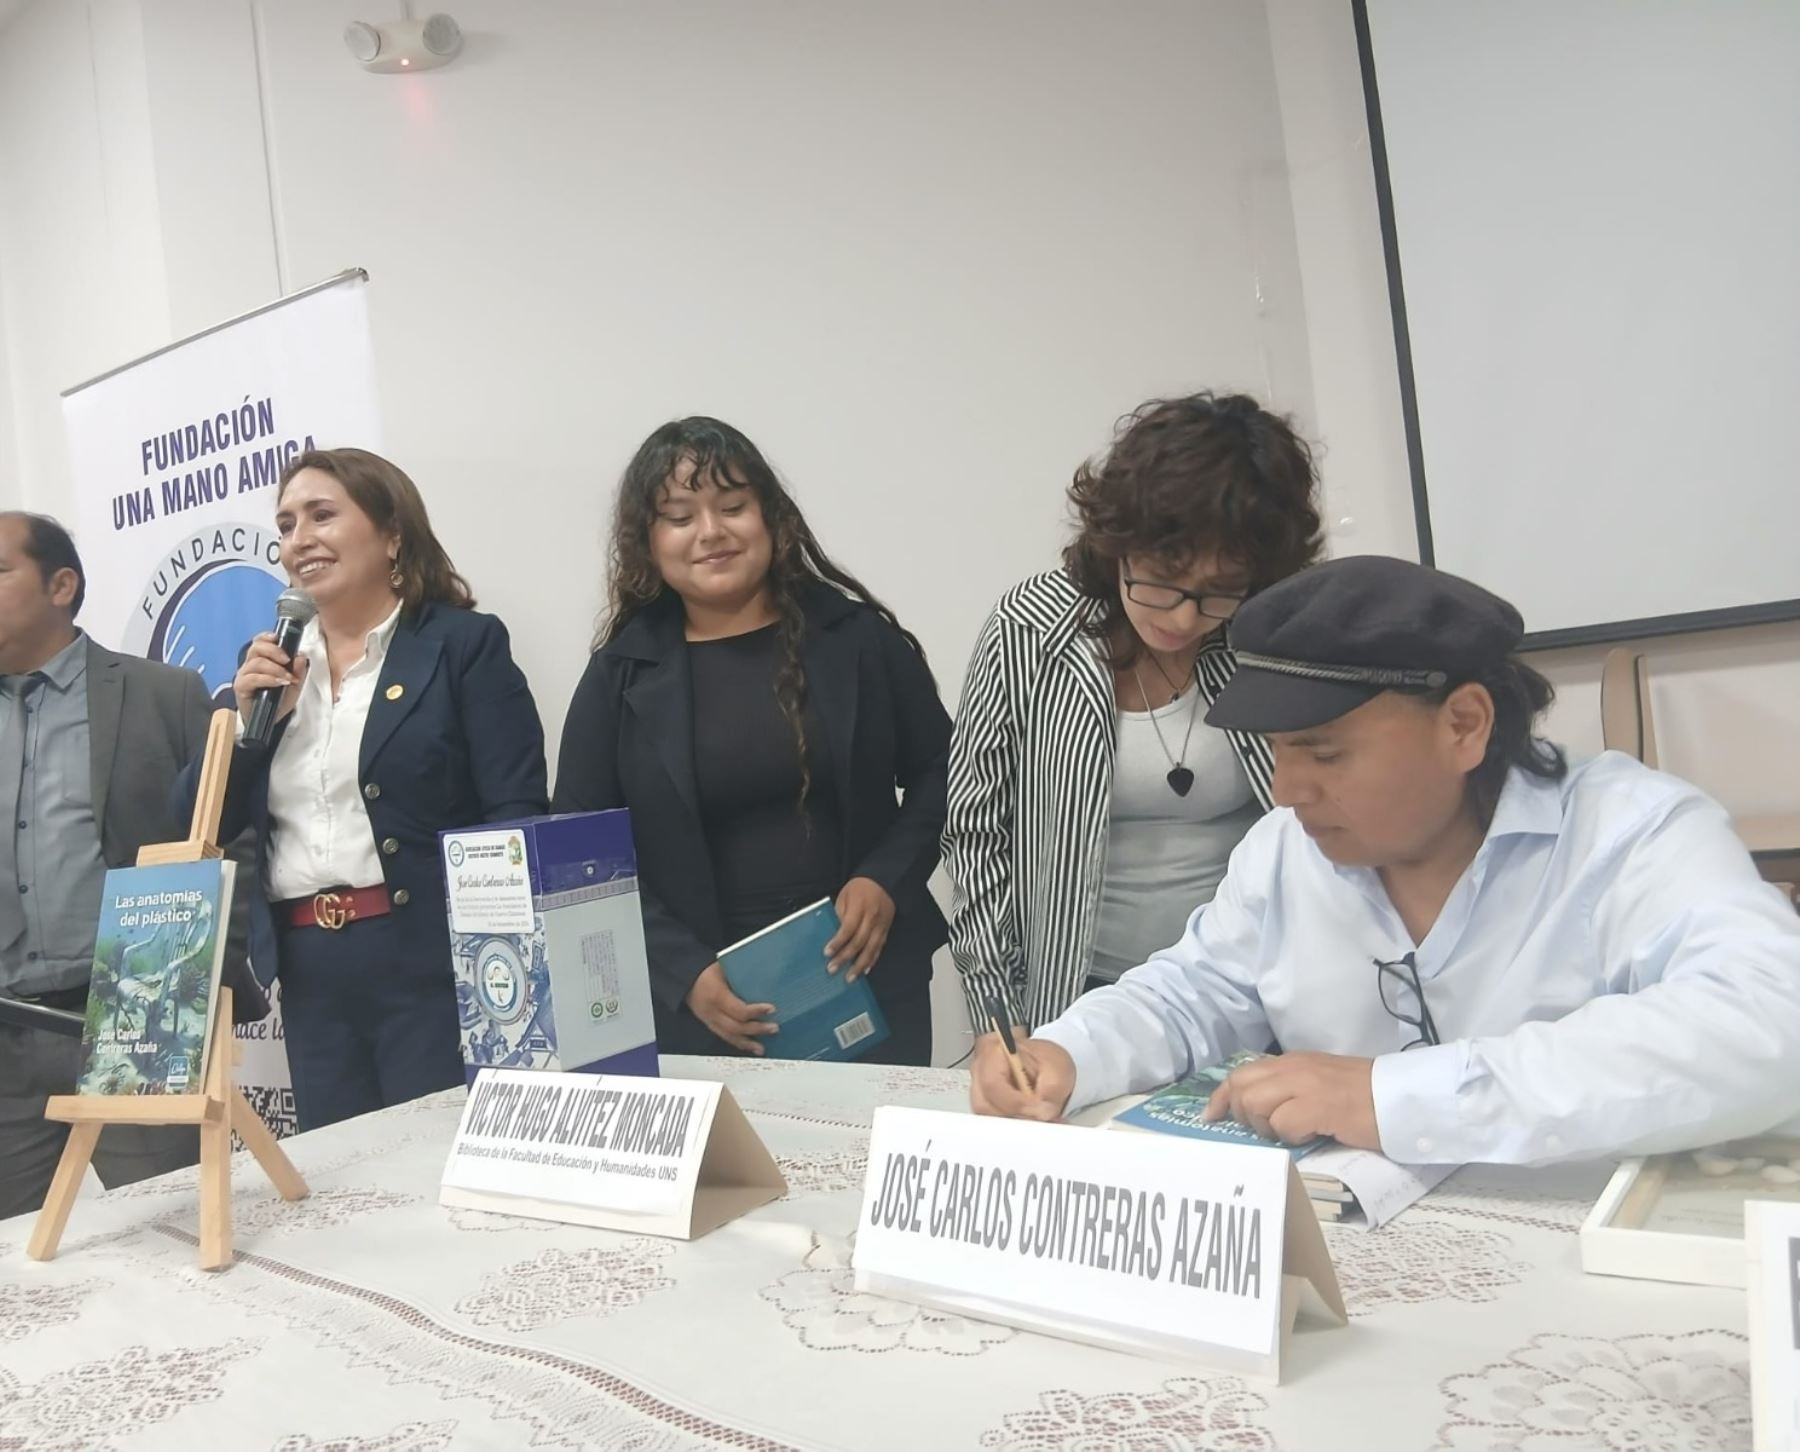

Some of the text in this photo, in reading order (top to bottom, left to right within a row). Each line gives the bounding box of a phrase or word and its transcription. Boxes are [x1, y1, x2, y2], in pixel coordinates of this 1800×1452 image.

[141, 394, 275, 476] FUNDACIÓN
[112, 486, 156, 531] UNA
[161, 467, 229, 517] MANO
[115, 895, 135, 909] Las
[120, 908, 192, 929] del plástico
[509, 1084, 562, 1143] HUGO
[609, 1091, 695, 1158] MONCADA
[457, 1142, 678, 1182] Biblioteca de la Facultad de Educación y Humanidades UNS
[871, 1139, 1262, 1299] JOSÉ CARLOS CONTRERAS AZAÑA
